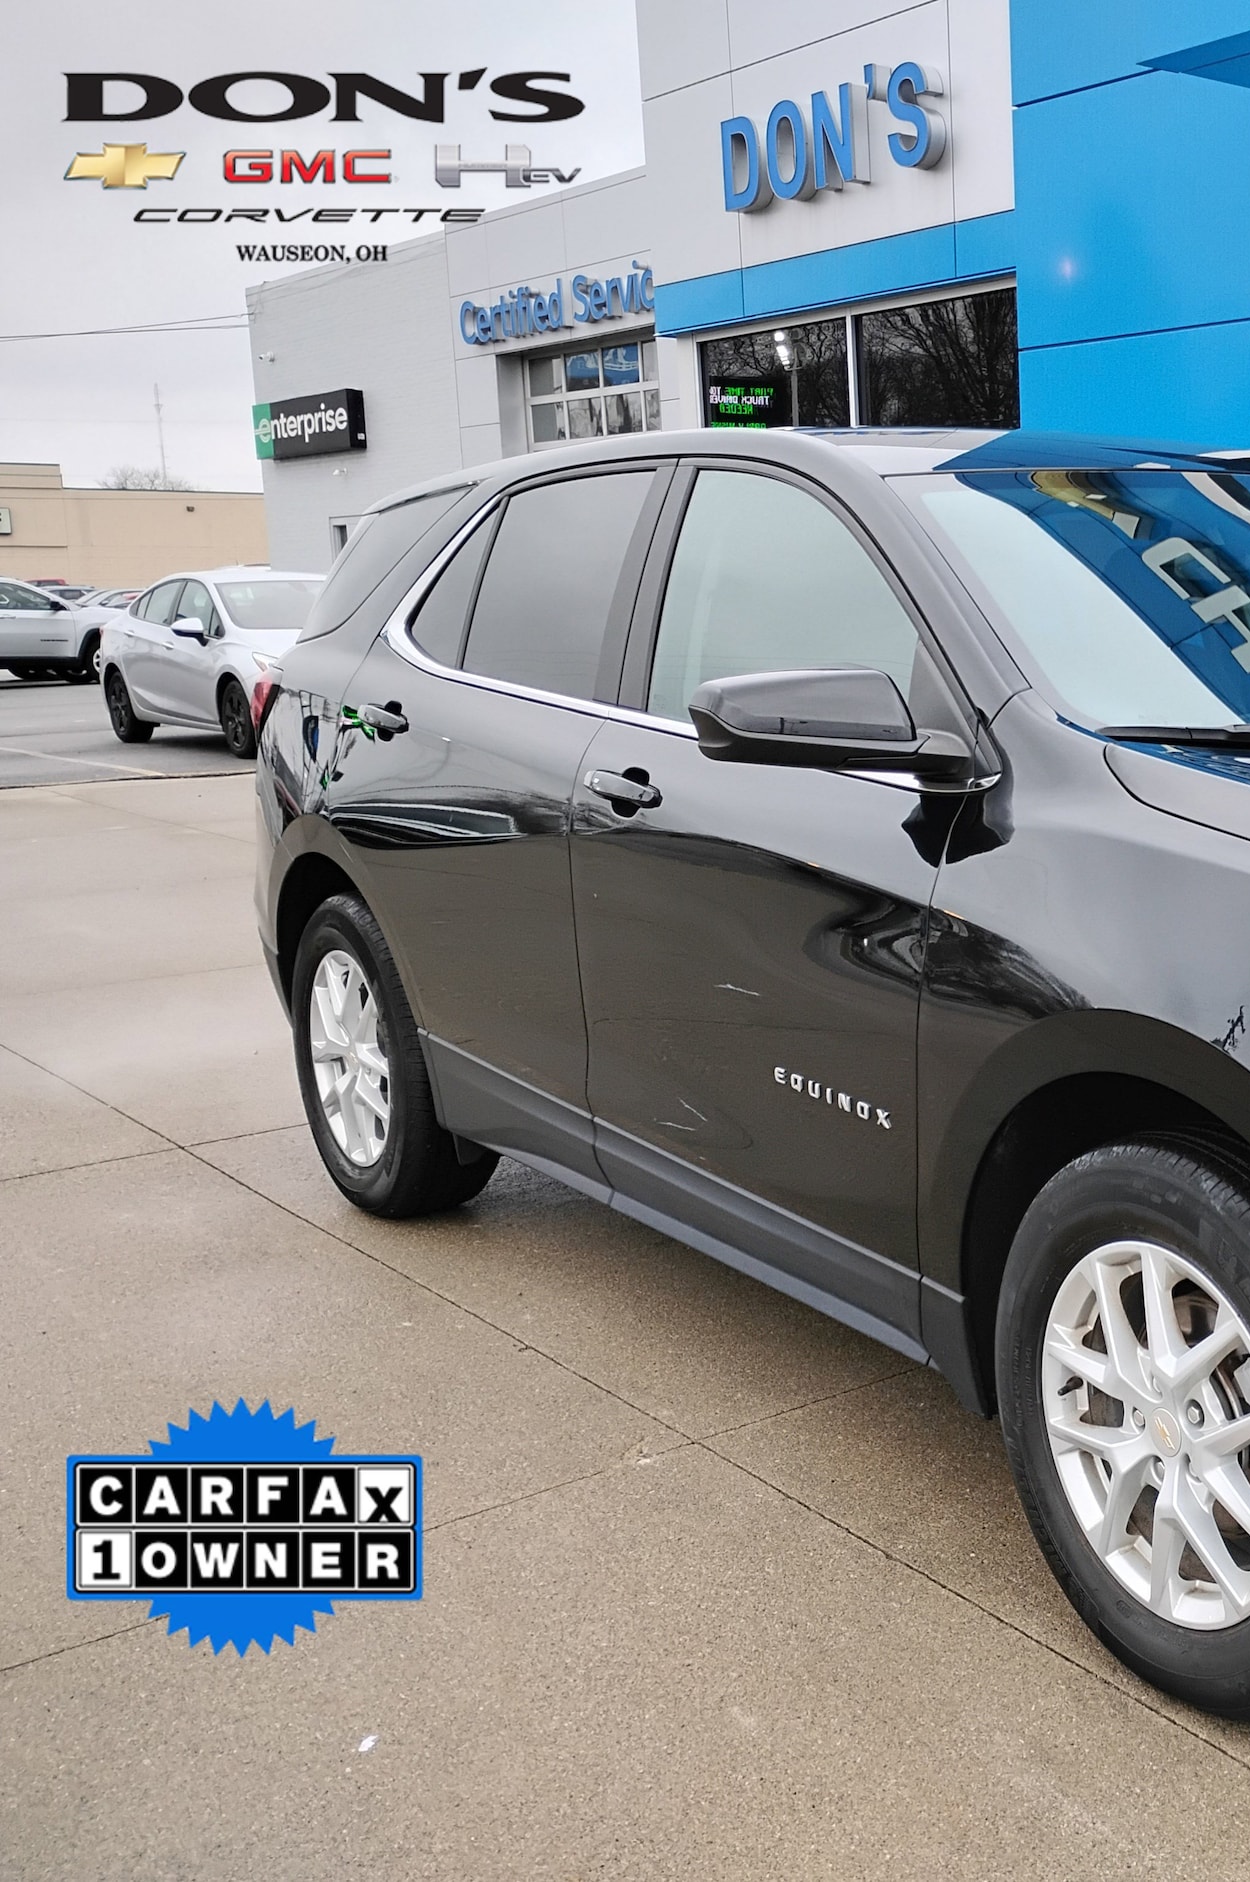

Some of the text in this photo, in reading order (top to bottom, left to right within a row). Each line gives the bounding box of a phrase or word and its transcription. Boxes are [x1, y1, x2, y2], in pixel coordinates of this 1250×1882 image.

[720, 60, 946, 213] DON'S
[460, 278, 567, 345] Certified
[257, 402, 348, 443] enterprise
[774, 1066, 892, 1130] EQUINOX
